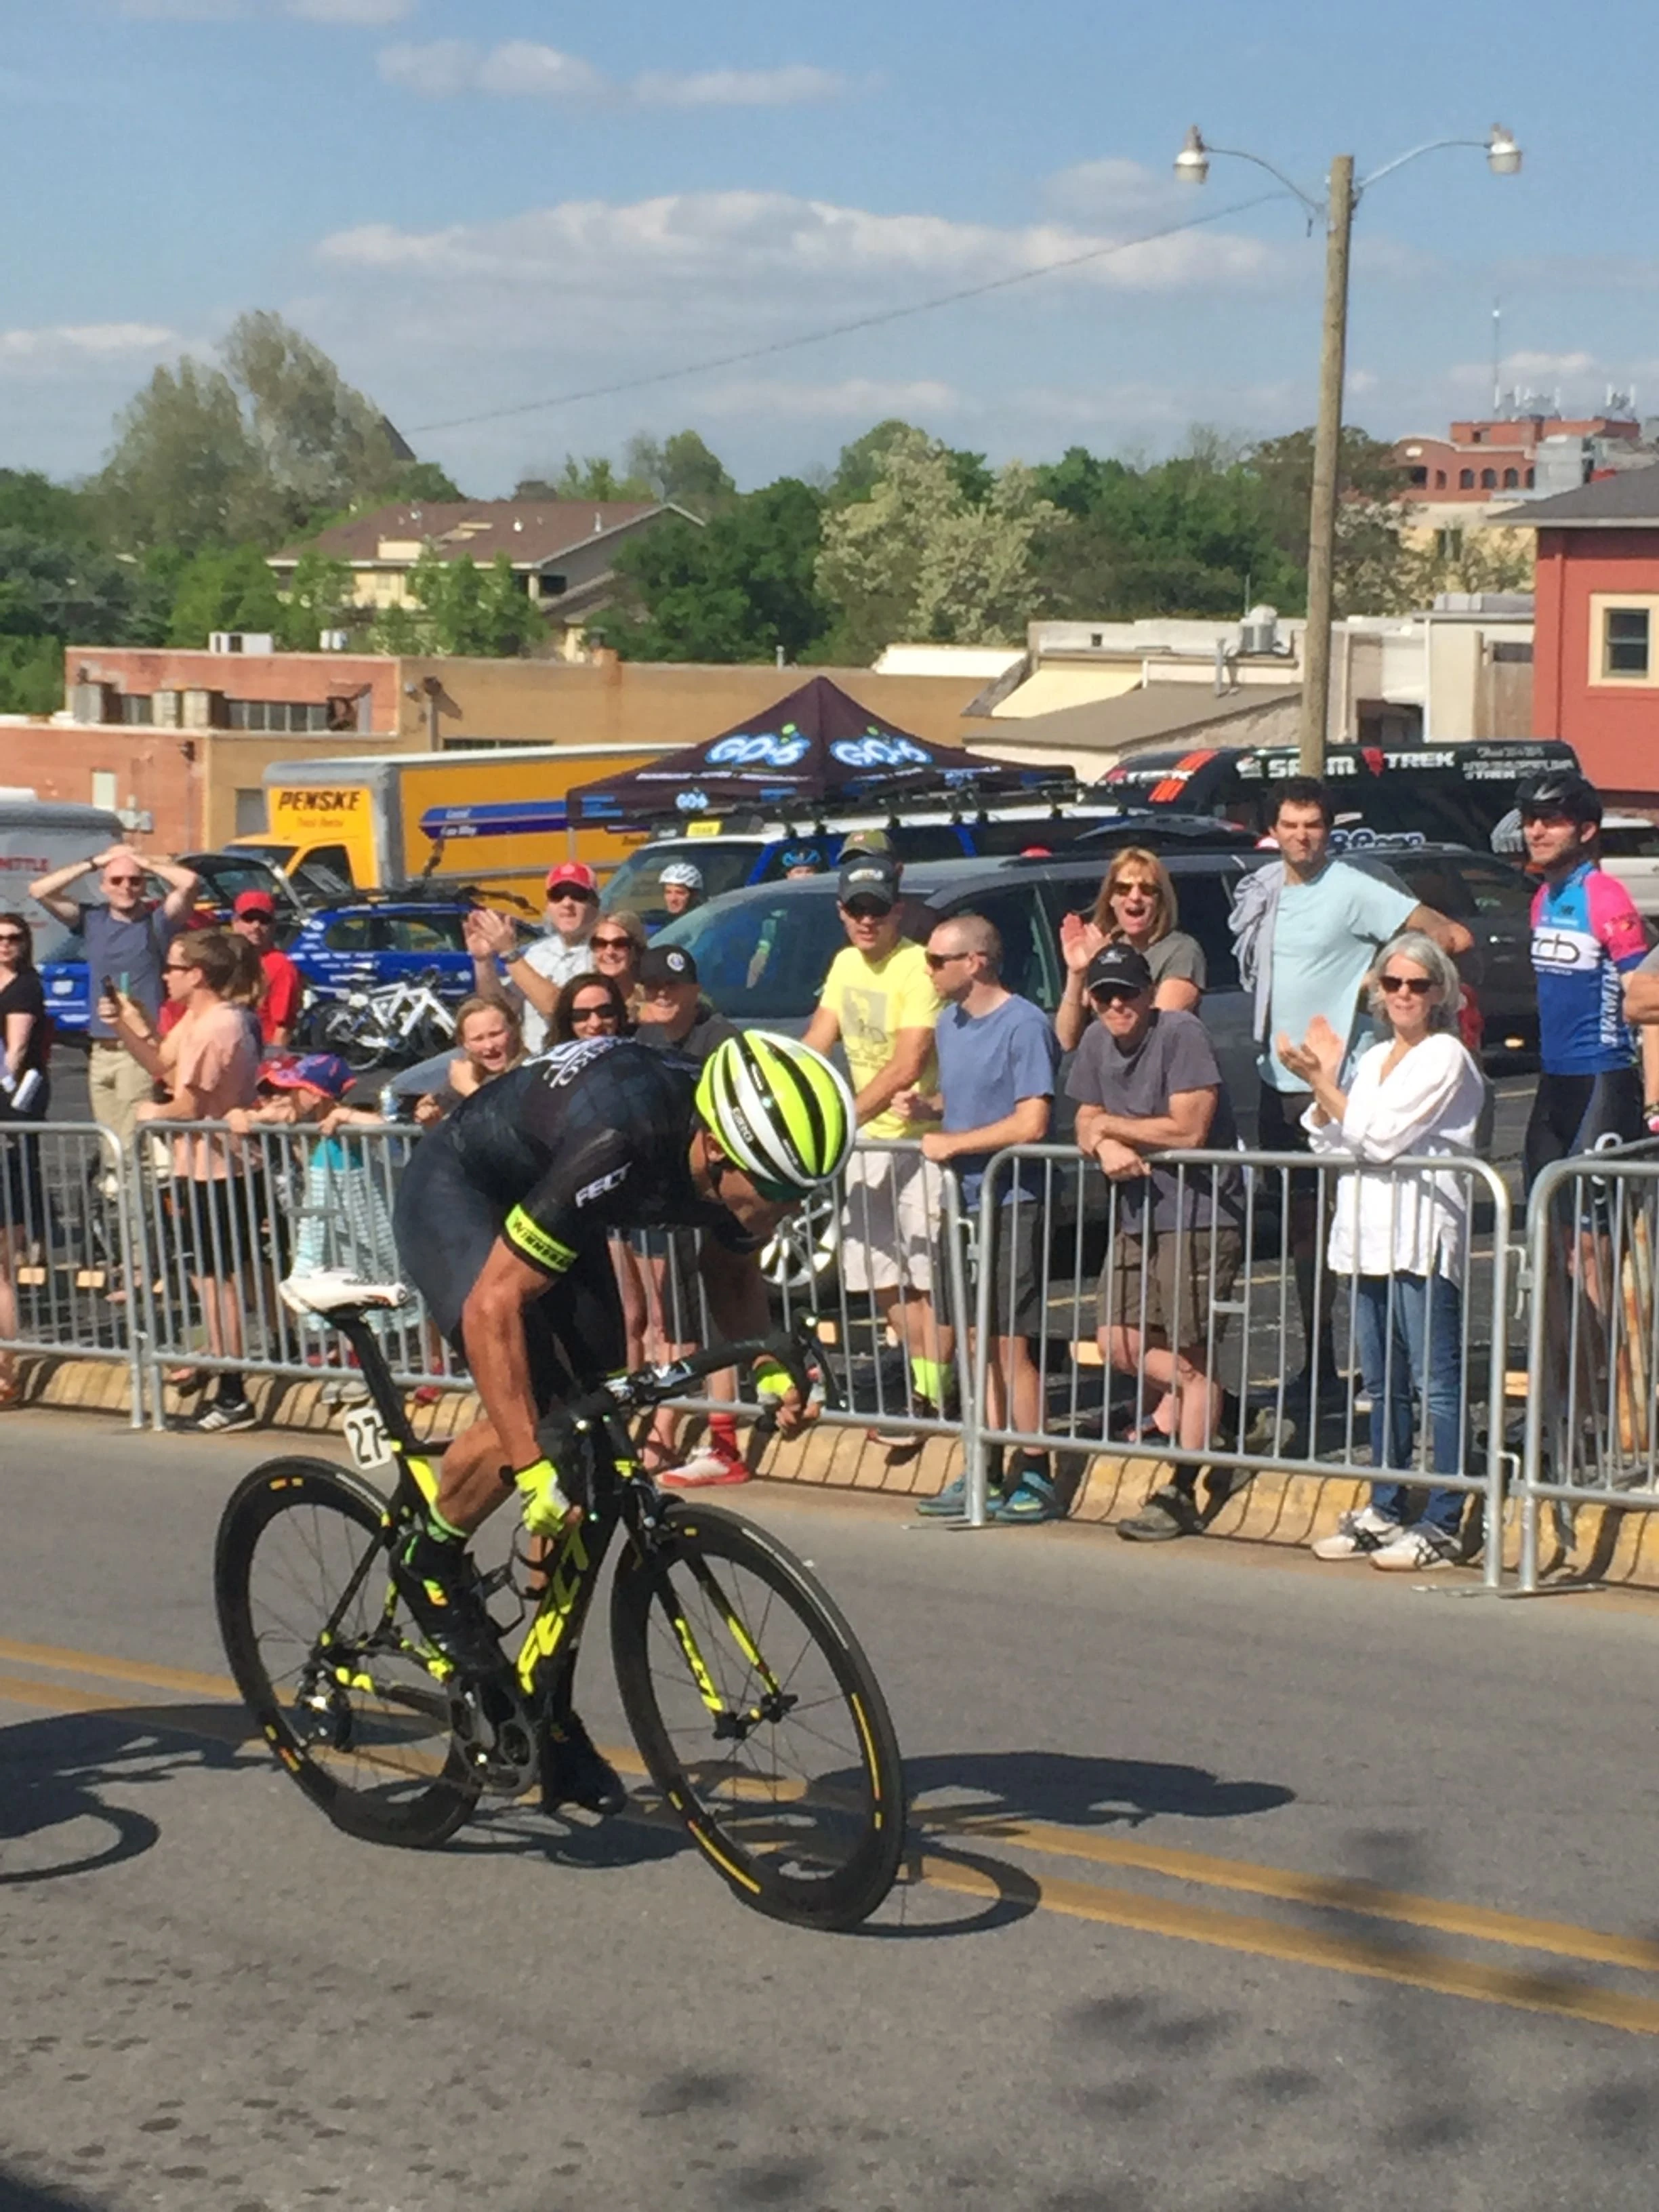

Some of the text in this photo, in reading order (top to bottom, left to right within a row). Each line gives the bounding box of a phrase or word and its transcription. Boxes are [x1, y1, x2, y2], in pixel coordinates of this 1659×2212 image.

[1268, 757, 1357, 779] SRM
[1383, 751, 1455, 769] TREK
[278, 790, 361, 811] PENSKE
[347, 1416, 382, 1465] 27
